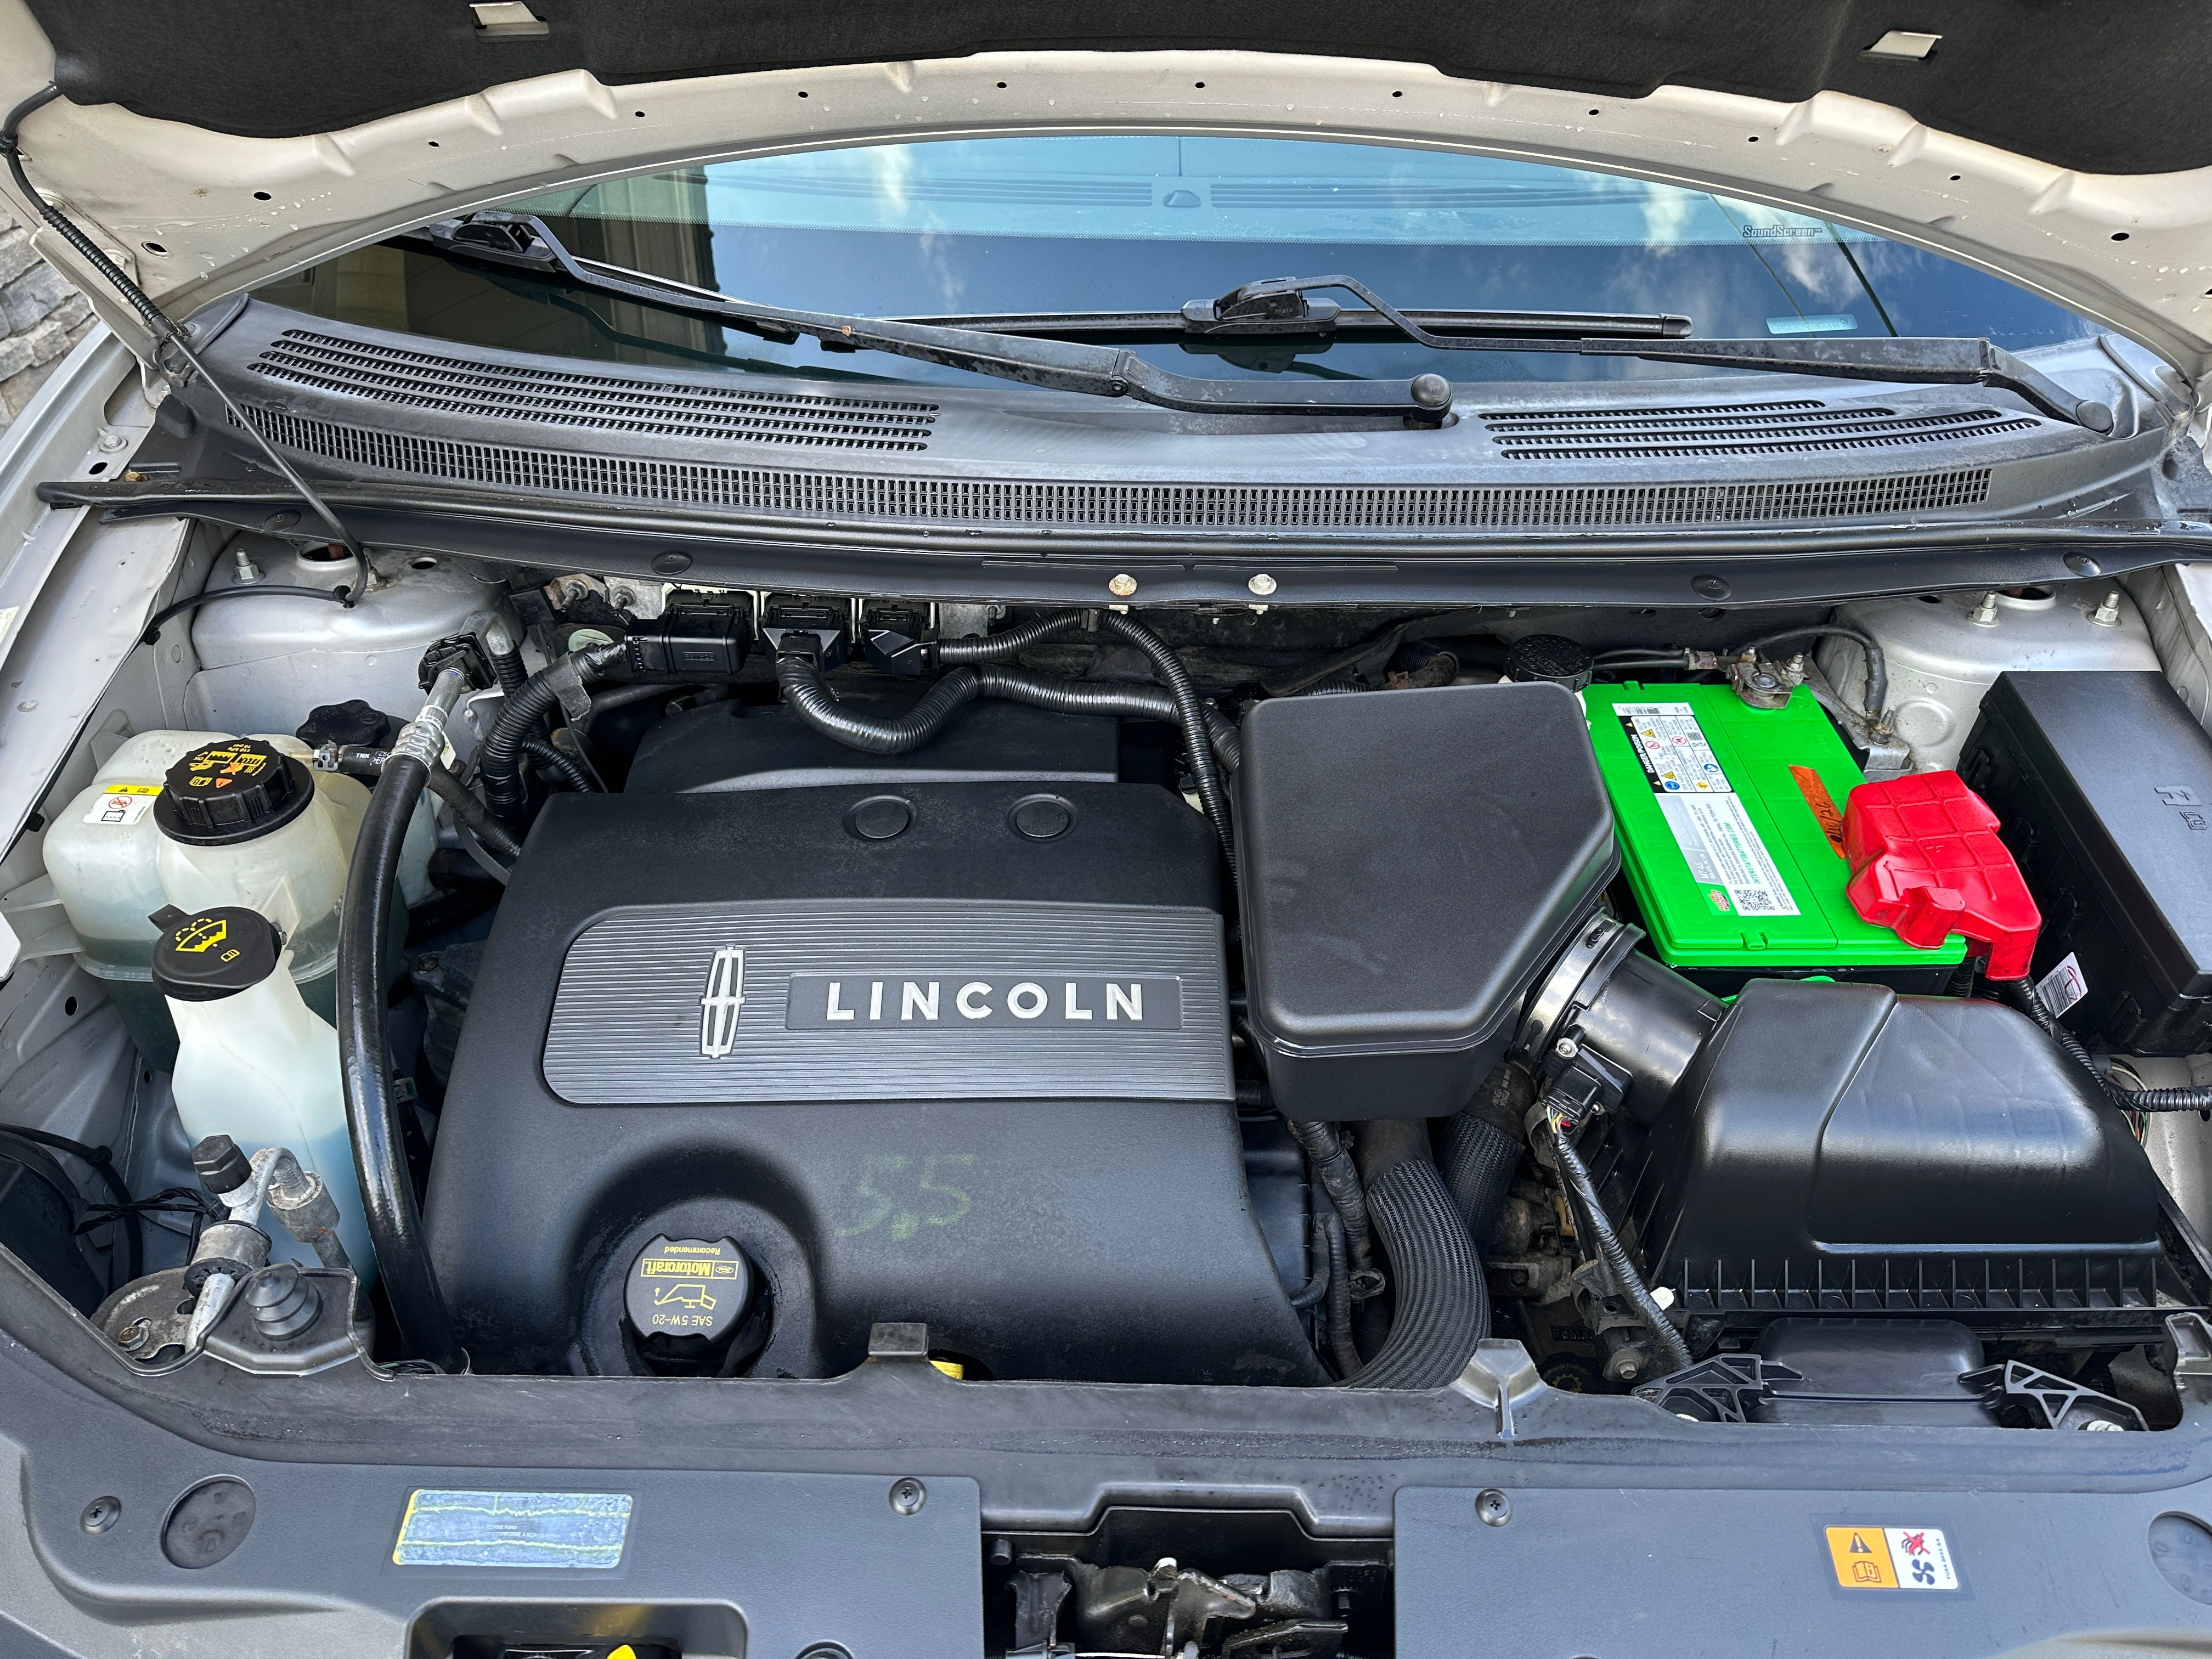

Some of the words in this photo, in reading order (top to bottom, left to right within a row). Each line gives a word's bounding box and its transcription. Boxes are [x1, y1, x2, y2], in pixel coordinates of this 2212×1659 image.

[1630, 734, 1655, 772] DANGER/POISON
[1723, 822, 1761, 883] INTERSTATEBATTERIES.COM
[1694, 862, 1709, 878] MT-65
[826, 981, 1143, 1021] LINCOLN
[664, 1246, 720, 1255] Recommended
[652, 1314, 689, 1325] 5W-20
[691, 1316, 713, 1327] SAE
